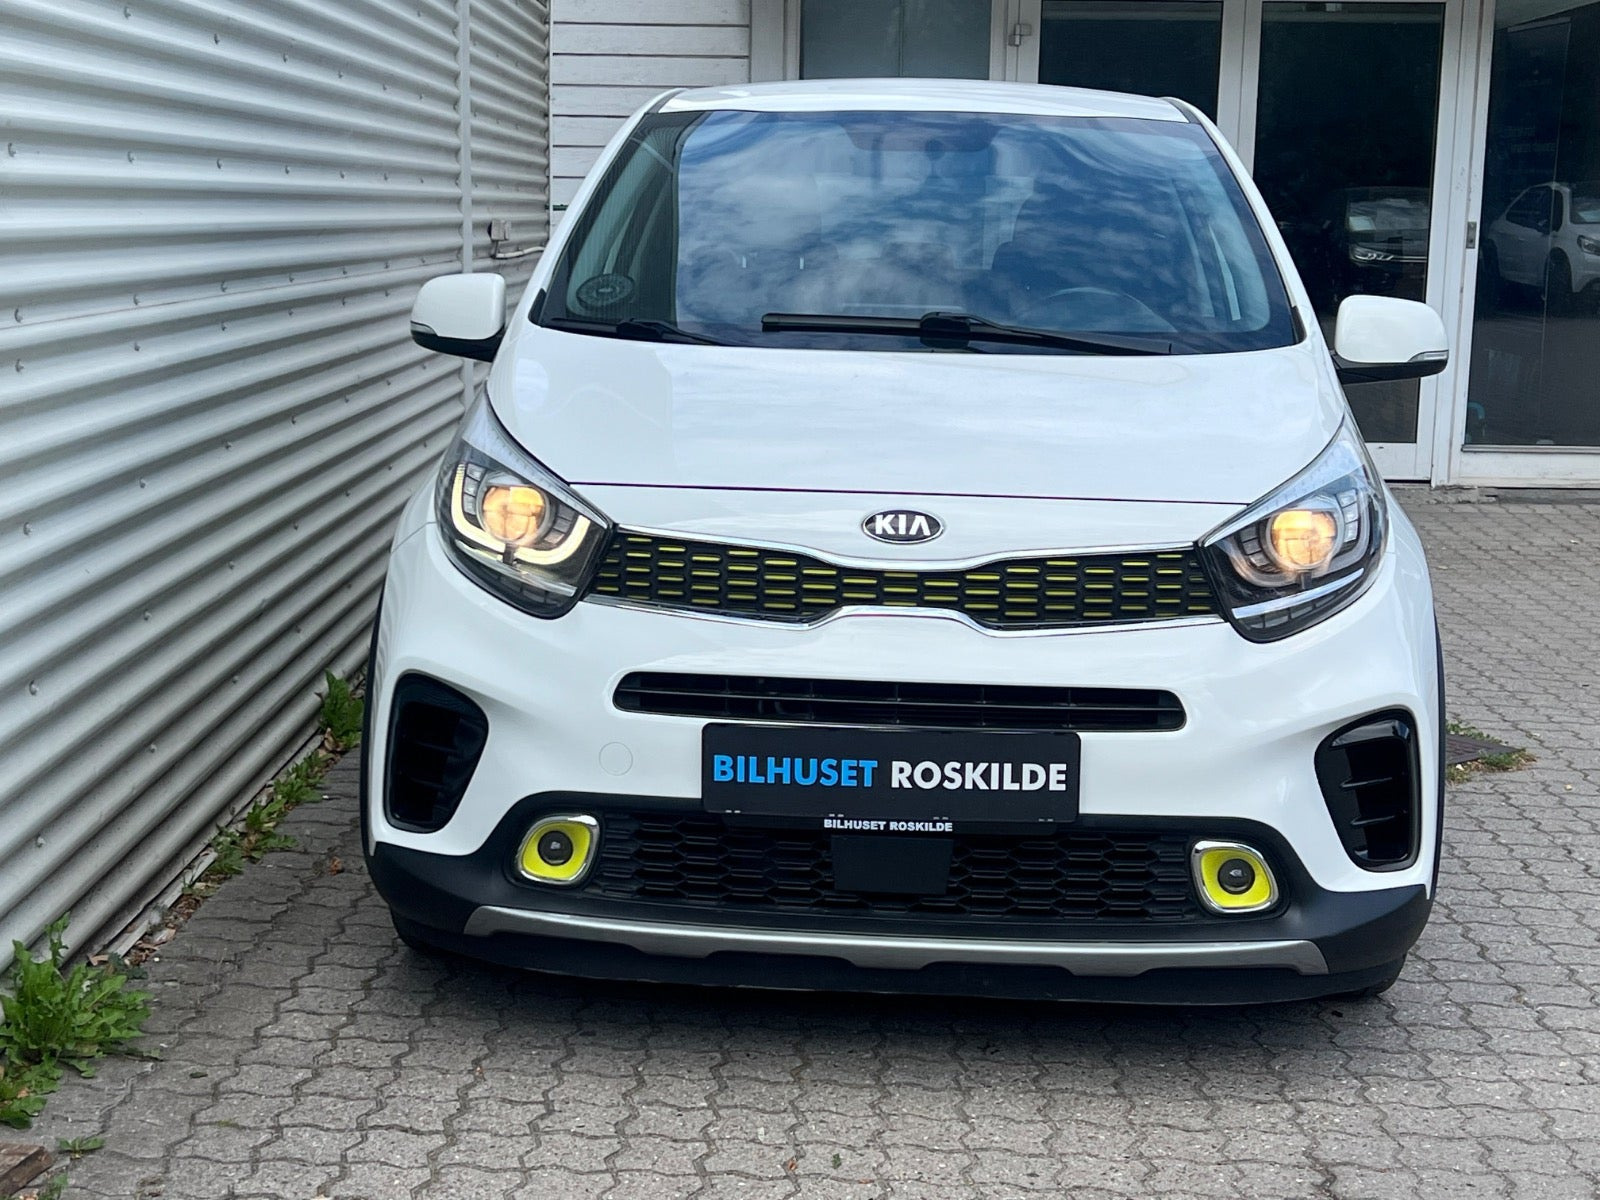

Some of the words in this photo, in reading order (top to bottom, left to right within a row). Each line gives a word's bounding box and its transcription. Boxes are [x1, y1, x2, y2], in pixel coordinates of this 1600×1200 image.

[875, 514, 931, 536] KIA
[713, 754, 878, 788] BILHUSET
[891, 760, 1067, 791] ROSKILDE
[823, 818, 887, 831] BILHUSET
[889, 821, 953, 832] ROSKILDE
